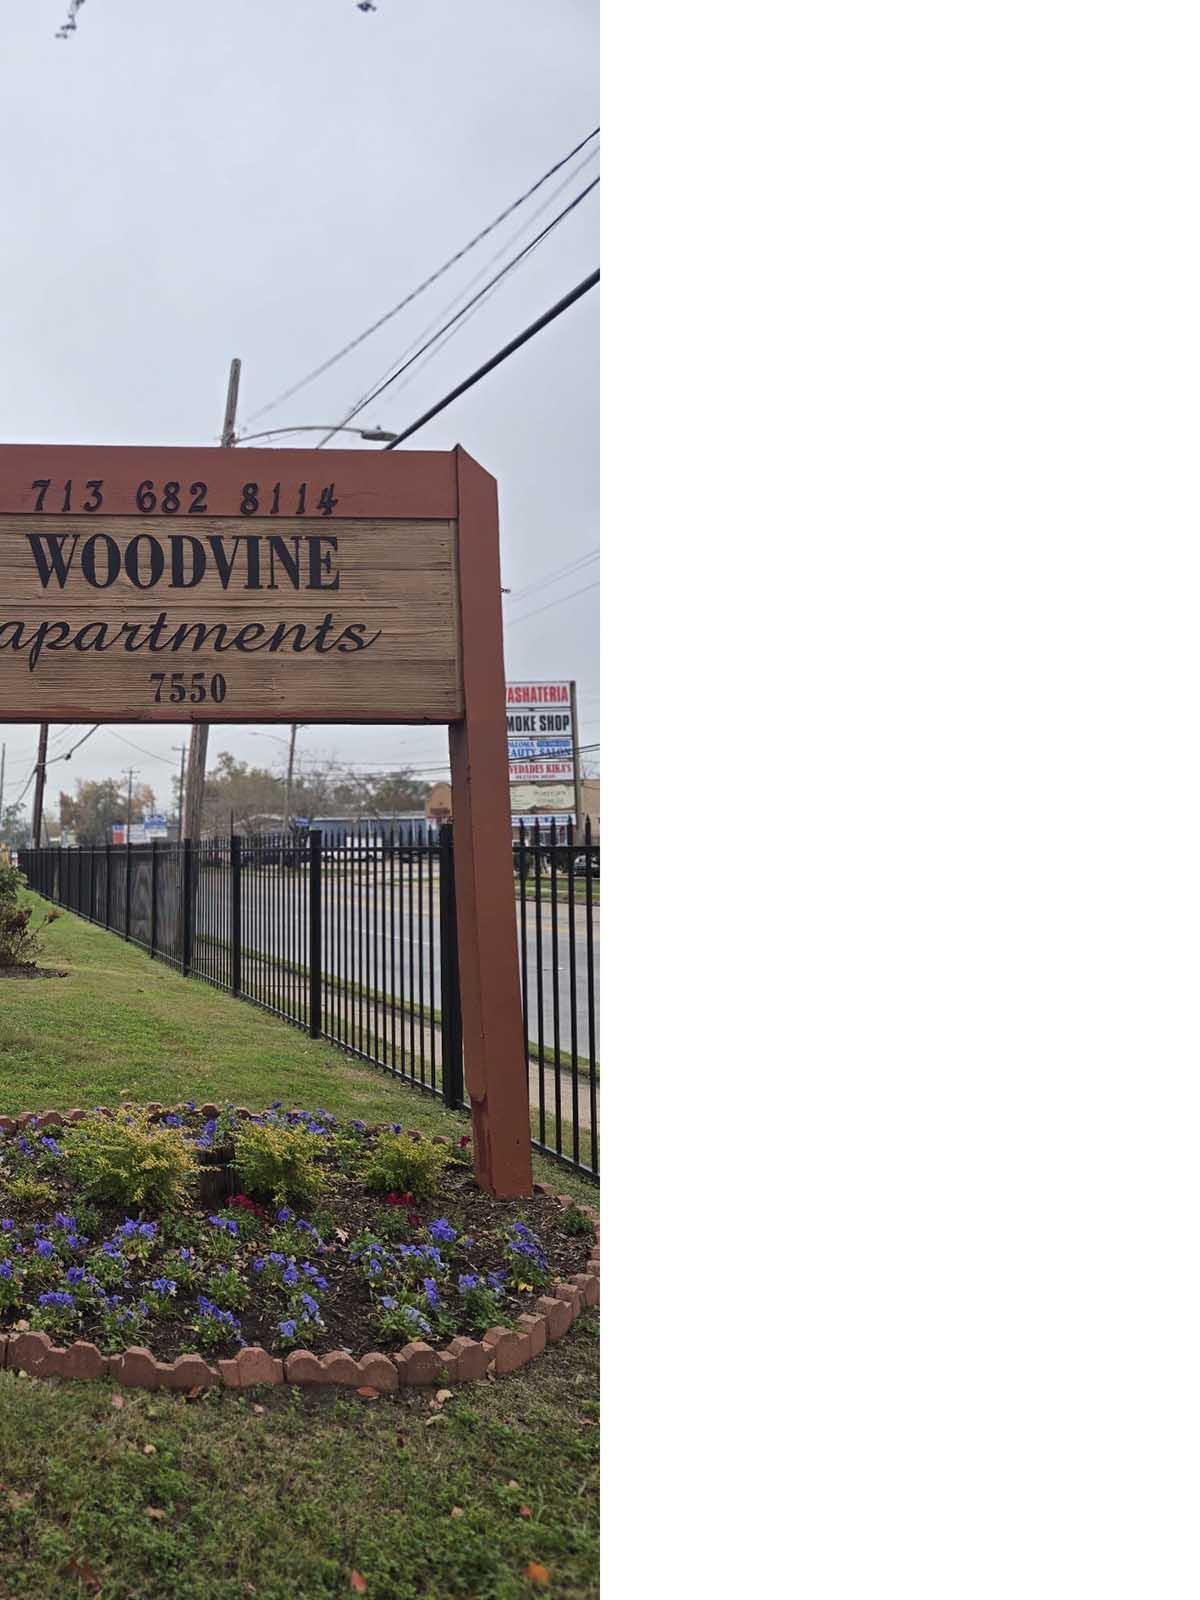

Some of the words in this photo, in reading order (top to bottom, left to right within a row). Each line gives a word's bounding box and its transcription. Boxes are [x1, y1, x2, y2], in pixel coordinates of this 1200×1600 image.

[31, 479, 104, 512] 713
[136, 479, 208, 514] 682
[240, 482, 339, 515] 8114
[26, 533, 340, 590] WOODVINE
[150, 672, 227, 703] 7550
[506, 685, 569, 703] ASHATERIA
[506, 714, 537, 732] MOKE
[539, 714, 570, 732] SHOP
[510, 747, 535, 757] AUTY
